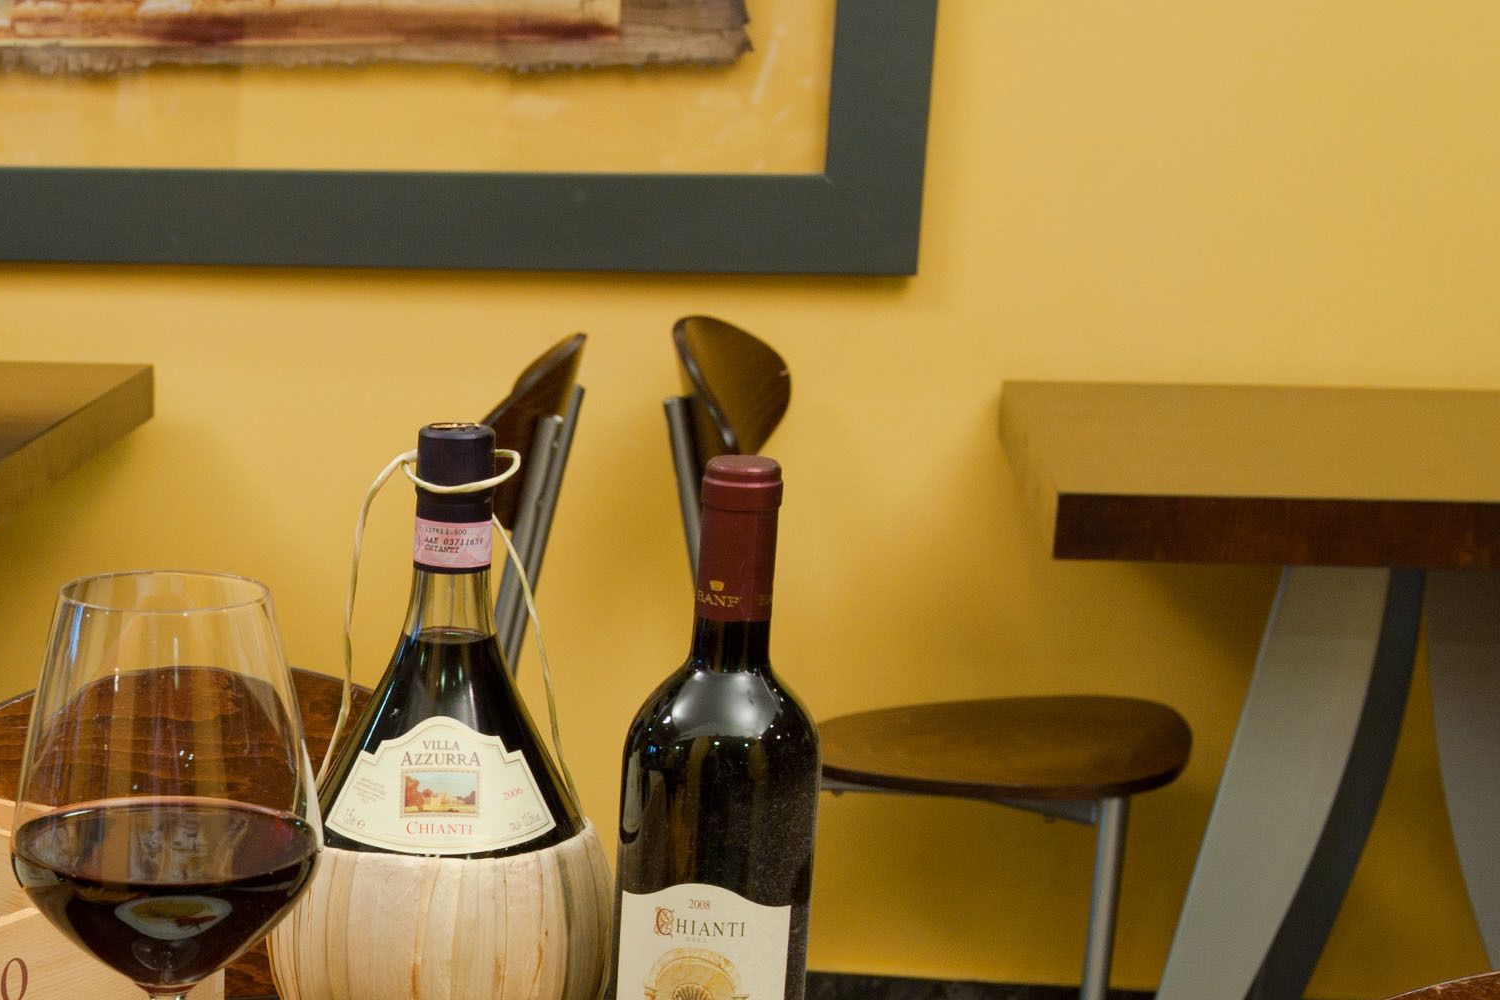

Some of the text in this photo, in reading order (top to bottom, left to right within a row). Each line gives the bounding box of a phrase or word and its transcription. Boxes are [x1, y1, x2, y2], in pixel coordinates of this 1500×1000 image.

[422, 740, 460, 750] VILLA
[401, 751, 482, 767] AZZURRA
[405, 821, 473, 836] CHIANTI
[688, 898, 711, 910] 2008
[653, 906, 746, 939] CHIANTI
